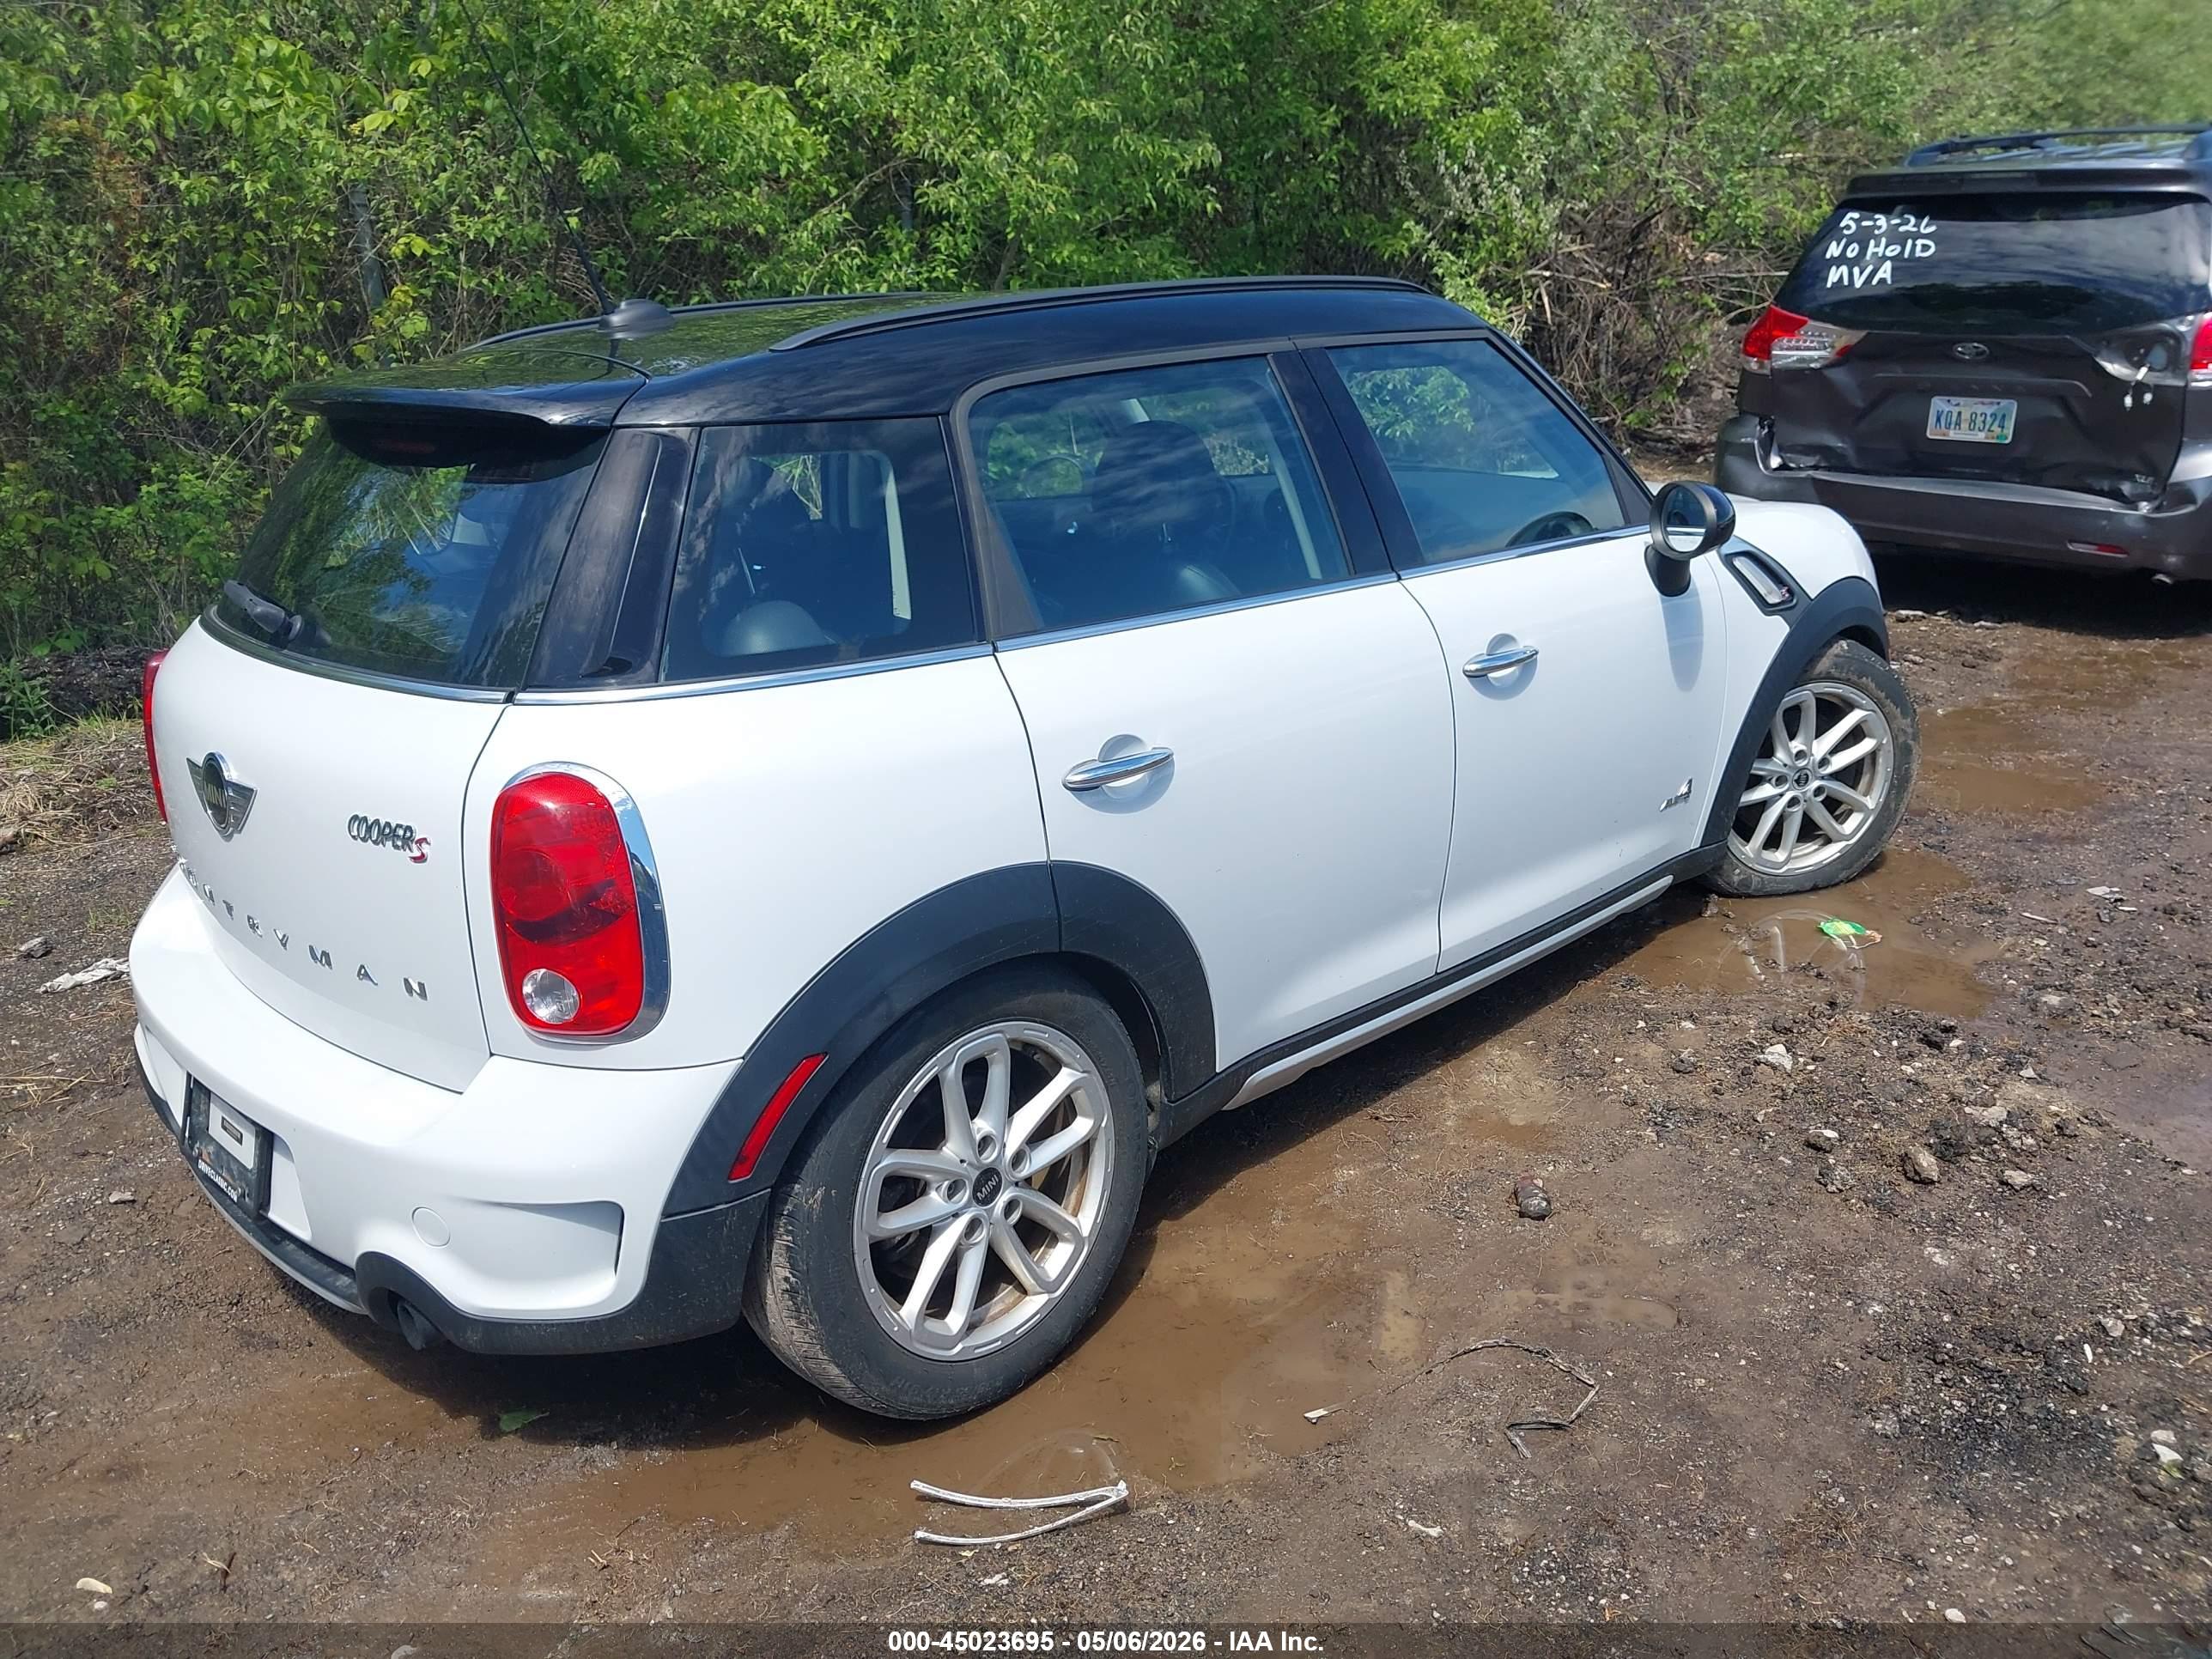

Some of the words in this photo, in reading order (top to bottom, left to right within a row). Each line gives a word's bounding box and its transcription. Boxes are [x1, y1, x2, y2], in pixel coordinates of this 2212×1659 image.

[1839, 212, 1938, 235] 5-3-26
[1826, 259, 1892, 289] MVA
[1967, 411, 2008, 434] 8324
[348, 814, 416, 853] COOPER
[976, 1174, 1000, 1200] MINI
